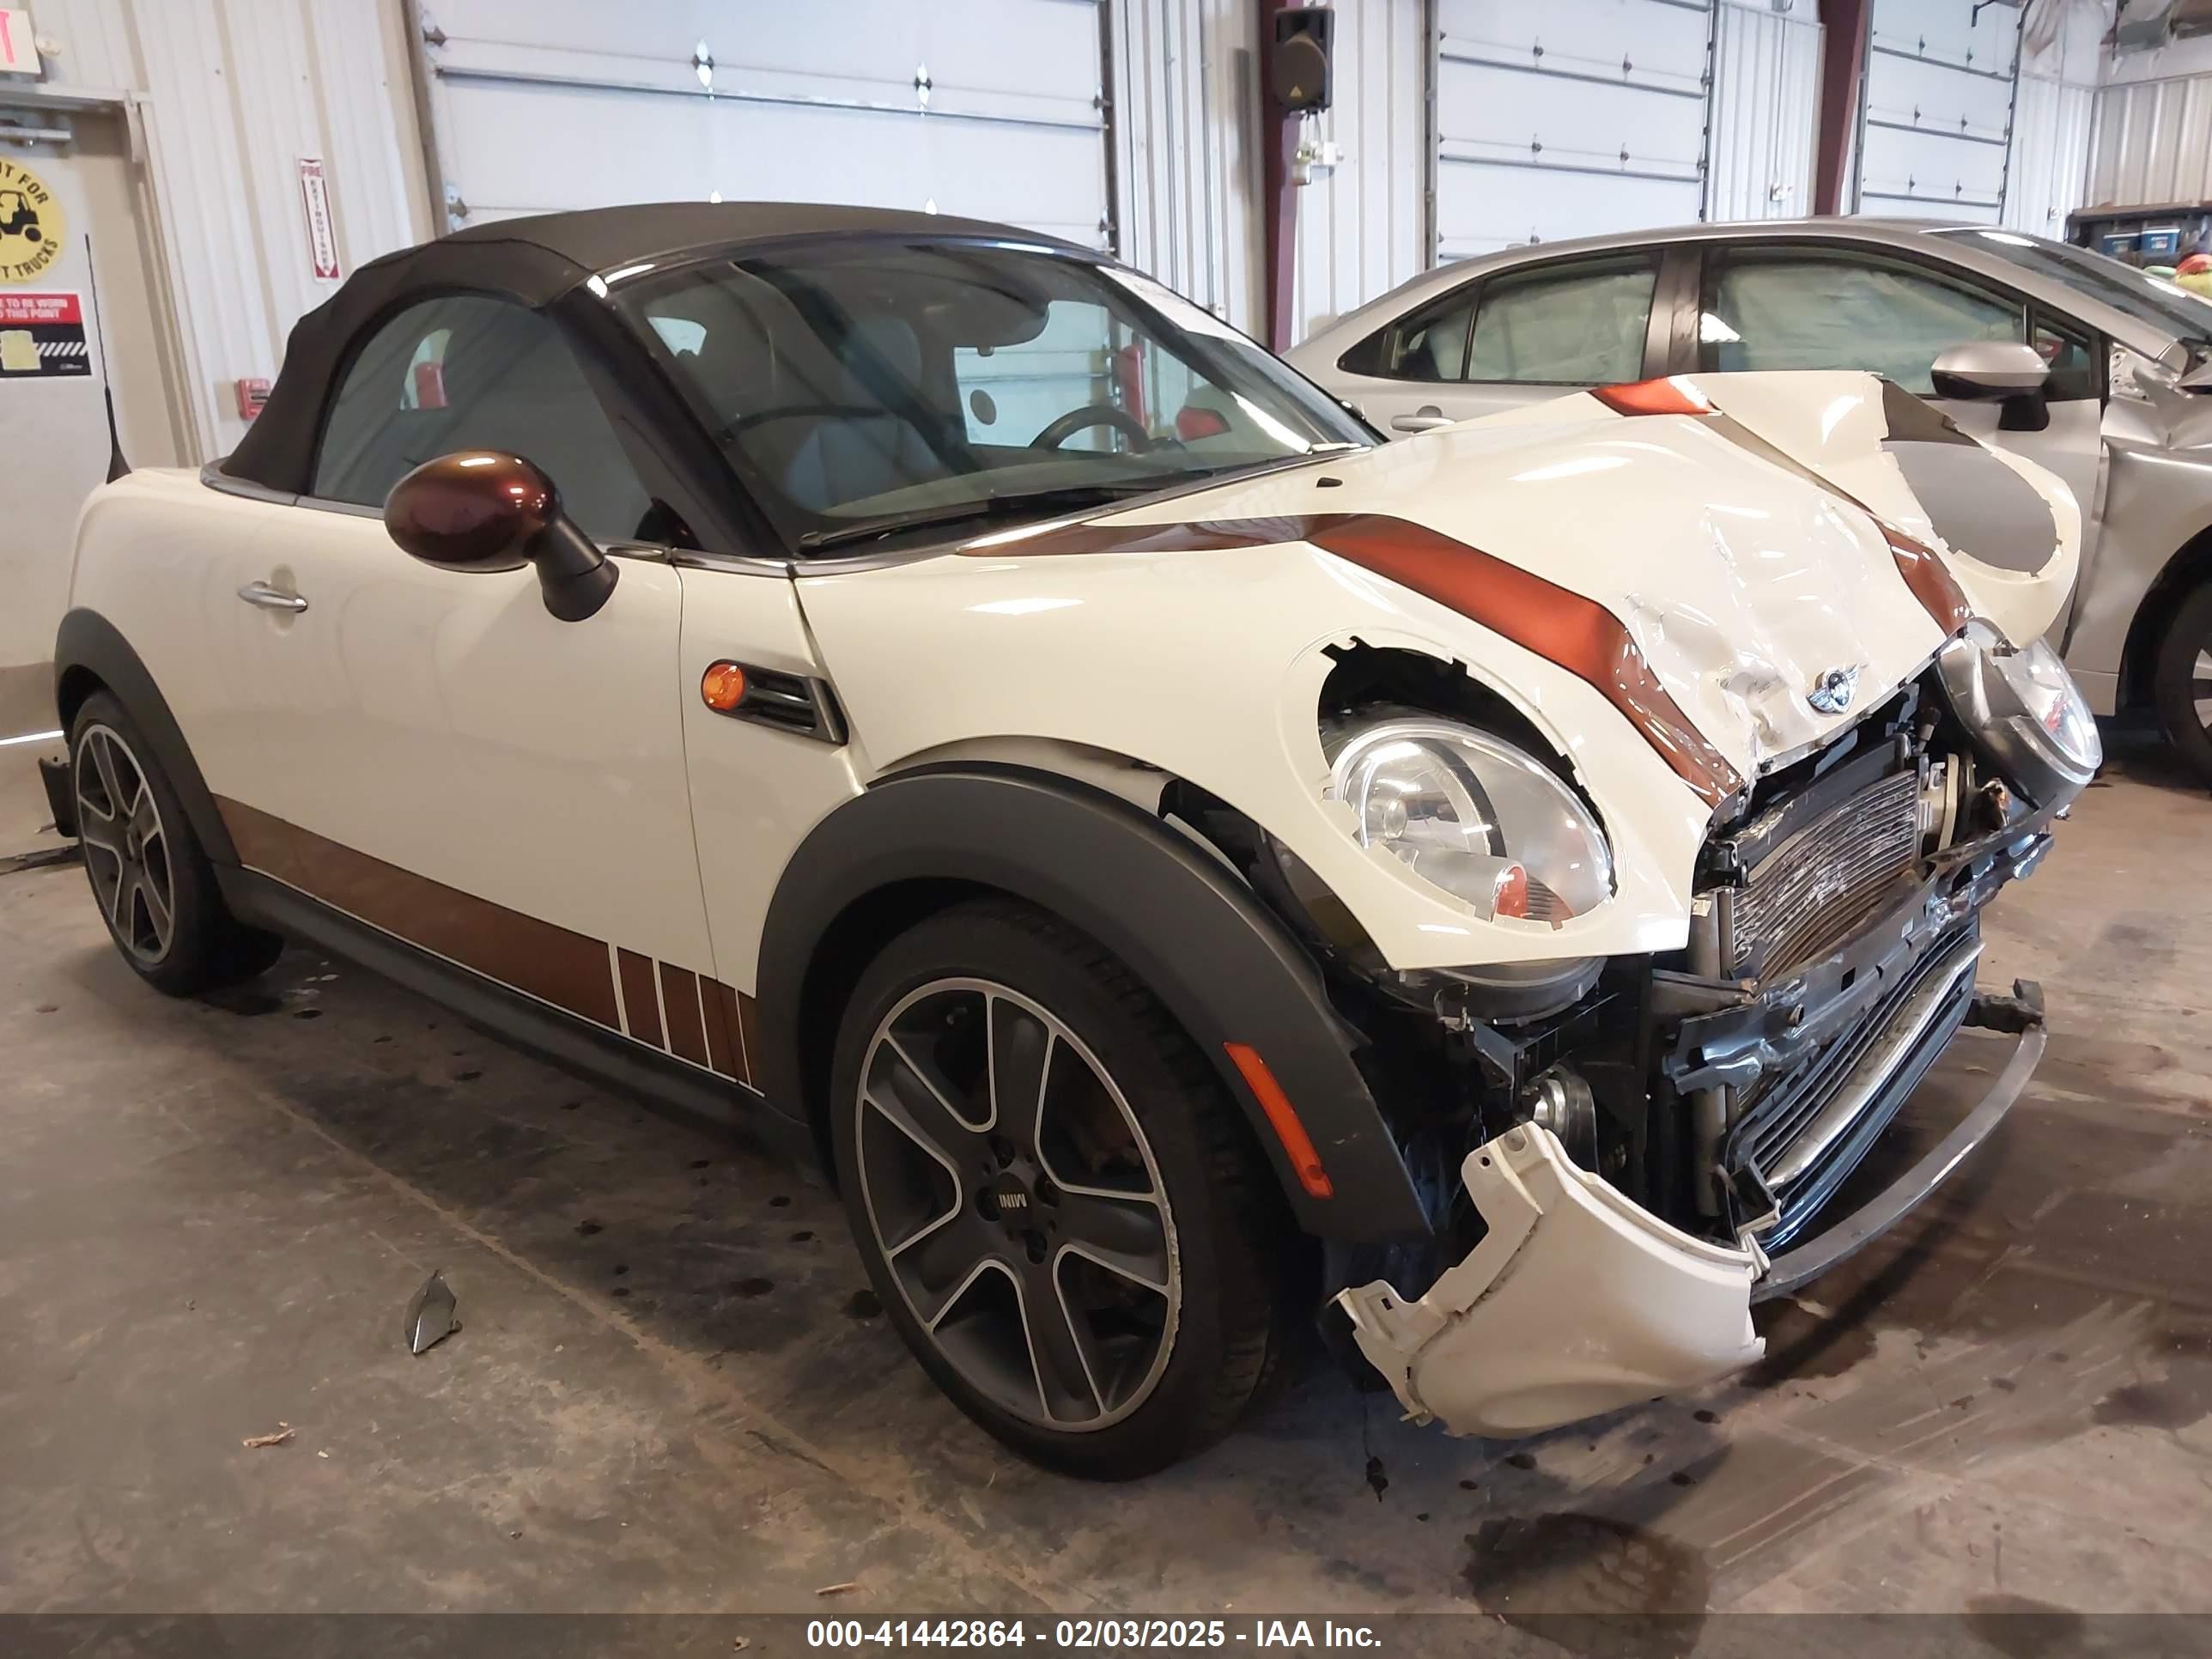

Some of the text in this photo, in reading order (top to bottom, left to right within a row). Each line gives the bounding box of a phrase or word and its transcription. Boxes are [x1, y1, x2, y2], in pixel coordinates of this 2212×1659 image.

[17, 173, 49, 204] FOR
[14, 238, 58, 276] TRUCKS
[5, 298, 21, 308] TO
[30, 308, 60, 319] POINT
[998, 1193, 1028, 1208] MINI
